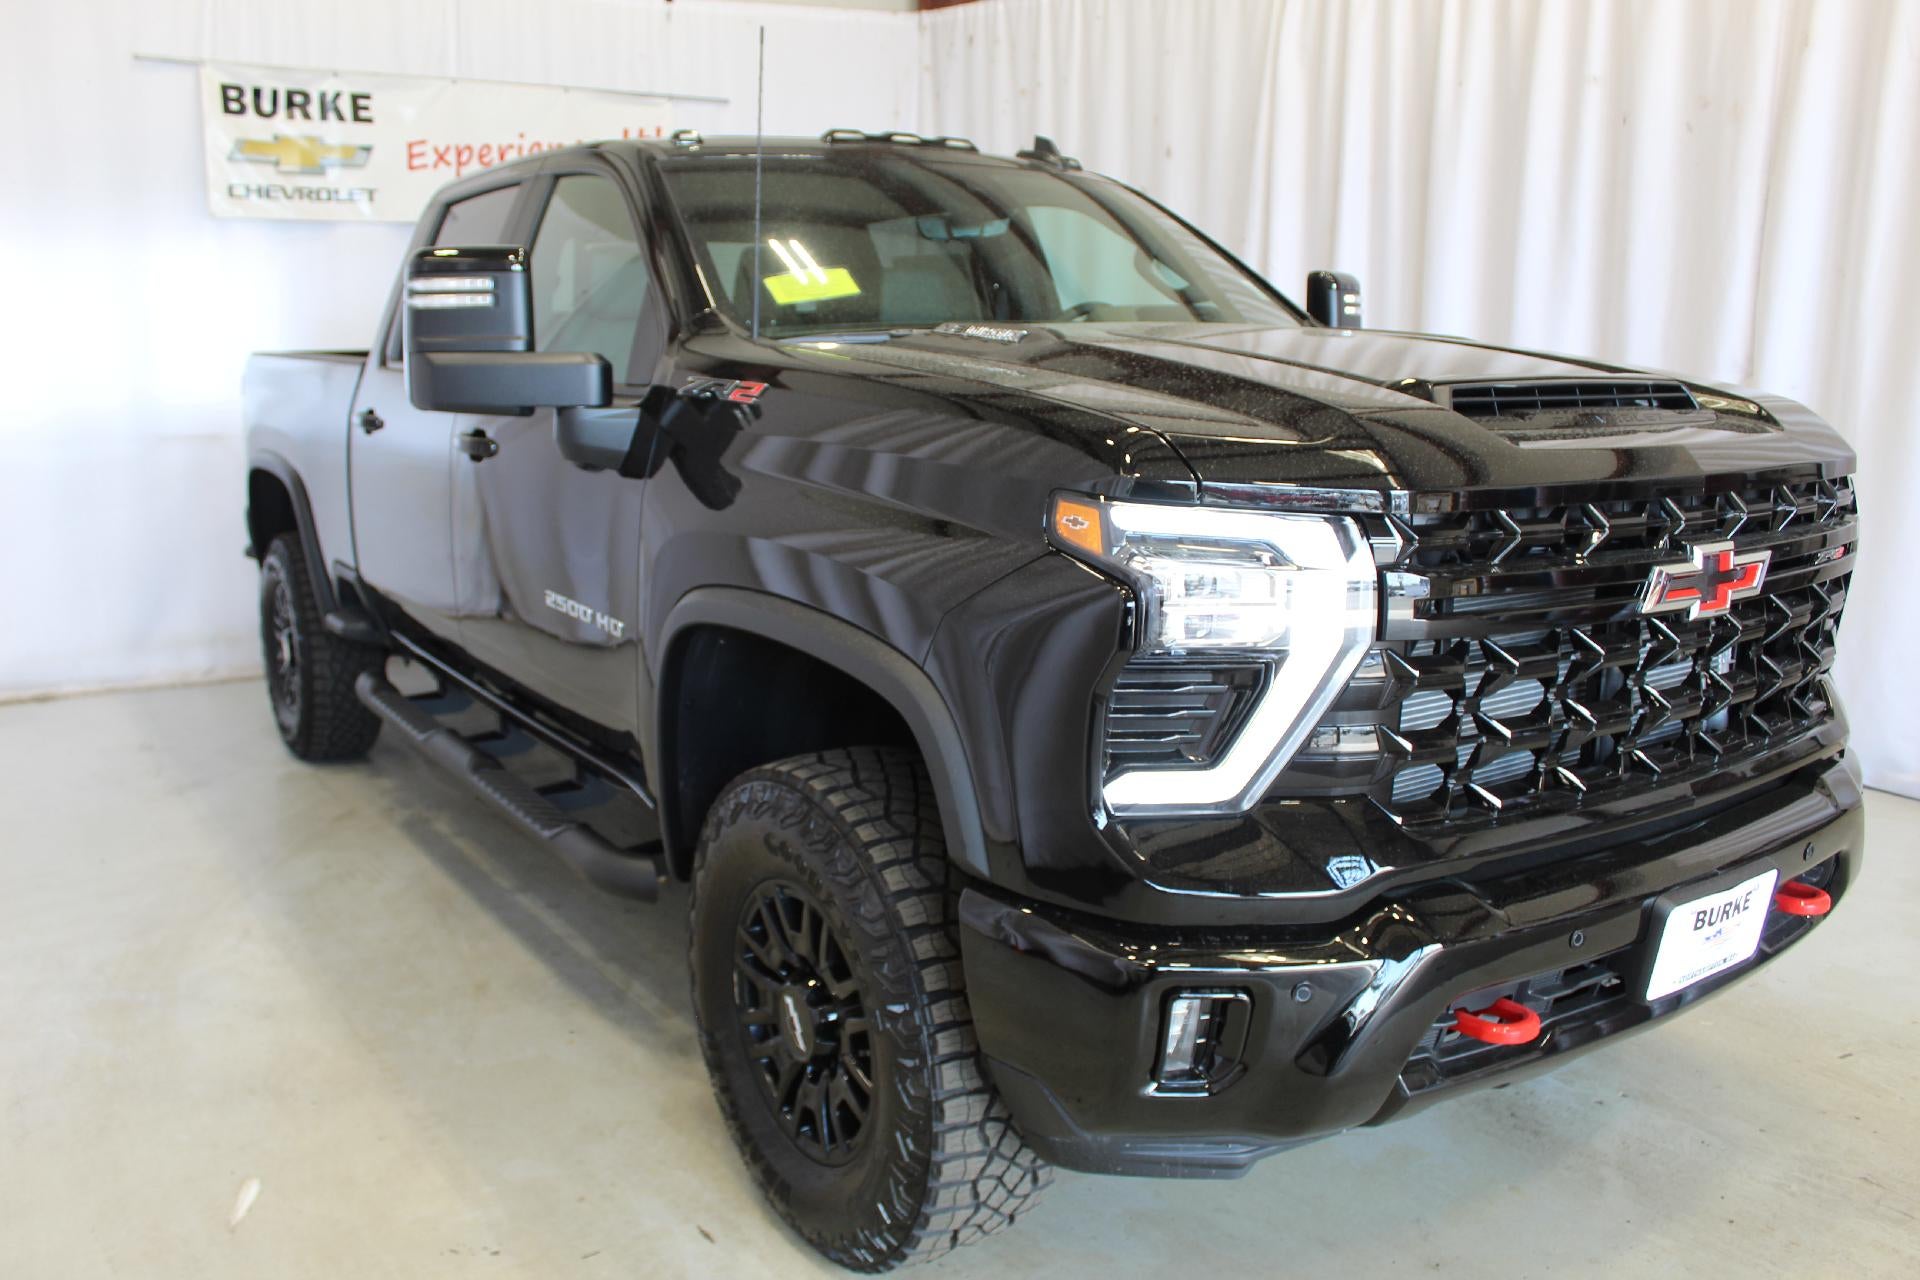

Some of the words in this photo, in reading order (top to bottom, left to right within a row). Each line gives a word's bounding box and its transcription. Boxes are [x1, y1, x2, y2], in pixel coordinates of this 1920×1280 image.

[220, 83, 374, 123] BURKE
[227, 183, 377, 202] CHEVROLET
[543, 589, 593, 624] 2500
[596, 611, 625, 638] HD
[1692, 890, 1753, 931] BURKE
